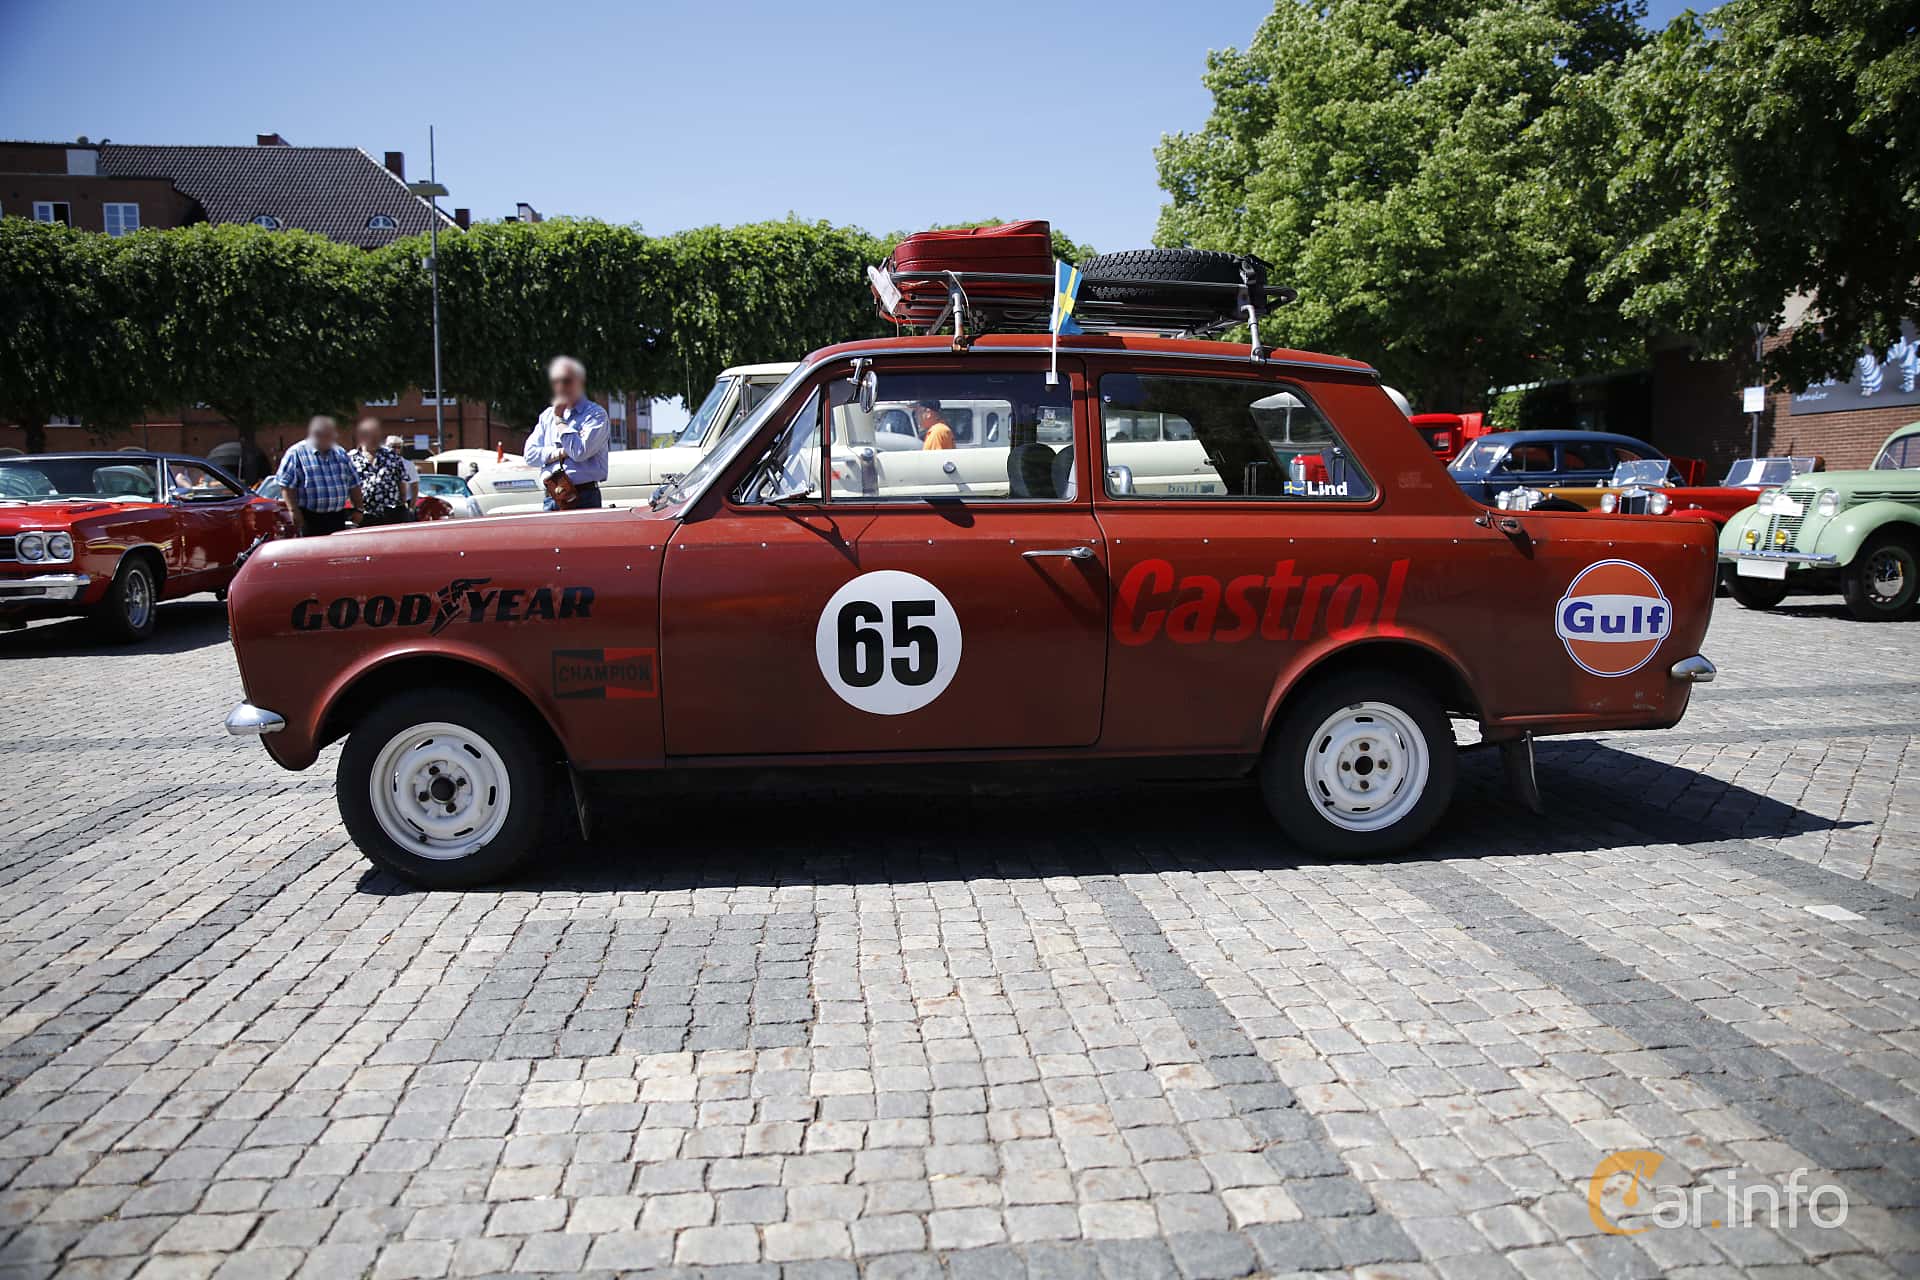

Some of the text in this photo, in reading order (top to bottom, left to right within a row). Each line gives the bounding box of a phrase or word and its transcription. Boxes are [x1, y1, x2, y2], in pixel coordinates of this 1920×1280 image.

[1307, 481, 1348, 496] Lind
[1112, 558, 1410, 646] Castrol
[1563, 601, 1665, 634] Gulf
[837, 599, 939, 688] 65
[558, 663, 651, 683] CHAMPION
